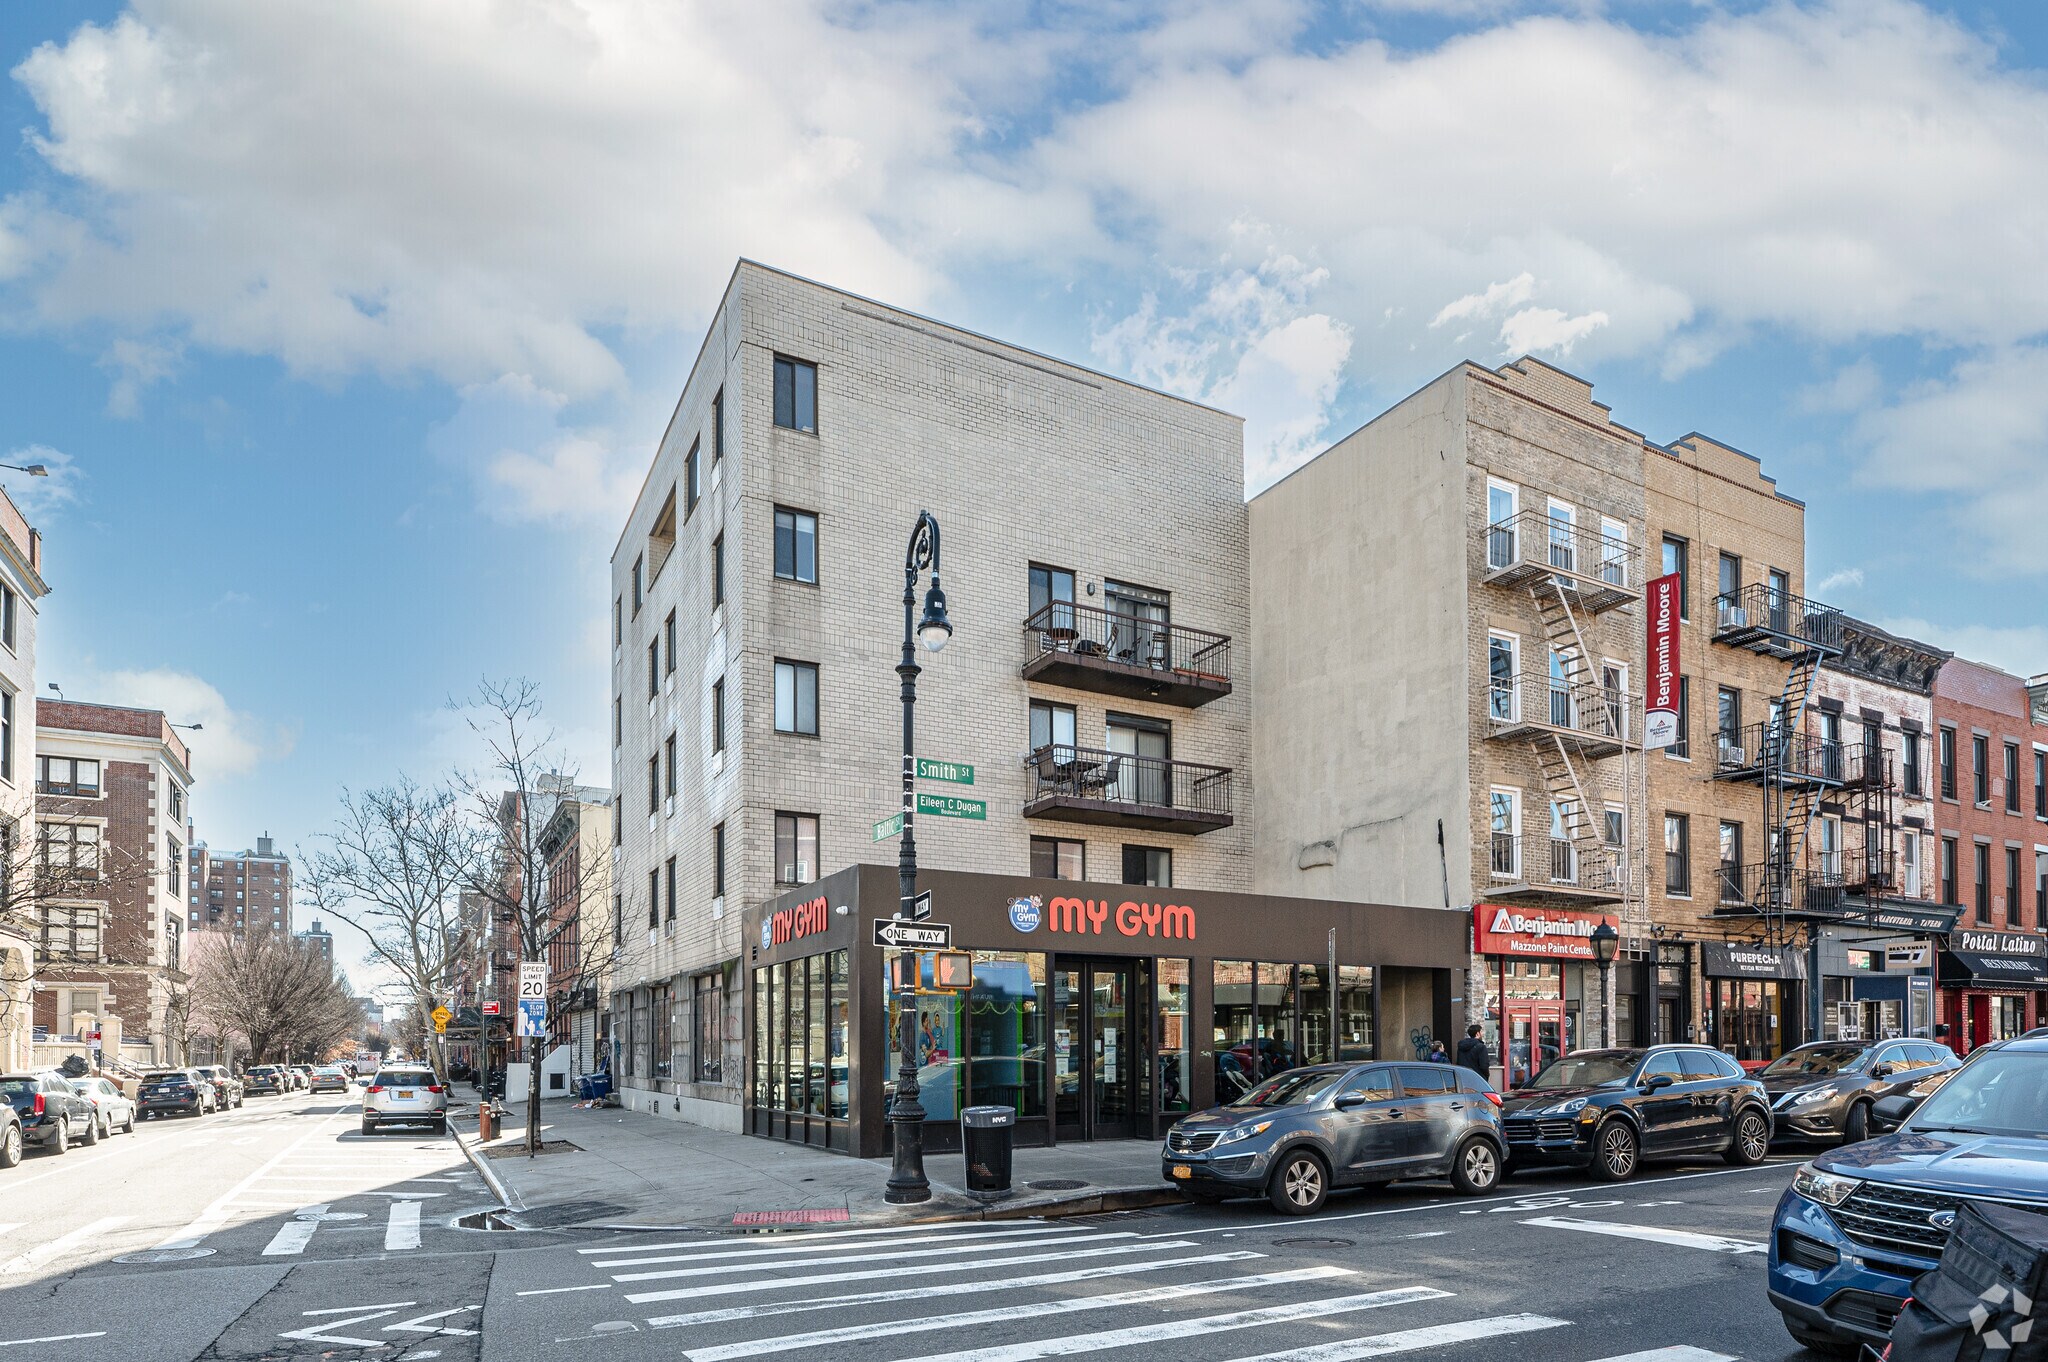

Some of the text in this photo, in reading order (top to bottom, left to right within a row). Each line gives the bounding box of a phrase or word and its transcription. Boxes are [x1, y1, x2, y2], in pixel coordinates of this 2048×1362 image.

[1656, 583, 1673, 706] Benjamin Moore
[920, 761, 969, 780] Smith St
[920, 795, 981, 814] Eileen C Dugan
[917, 900, 928, 914] WAY
[773, 908, 794, 945] MY
[795, 896, 828, 939] GYM
[1016, 912, 1037, 922] GYM
[1049, 896, 1196, 940] MY GYM
[1514, 914, 1618, 938] Benjamin Moe
[886, 928, 941, 942] ONE WAY
[1962, 932, 2036, 953] Portal Latino
[1511, 940, 1546, 952] Mazzone
[1548, 942, 1568, 953] Paint
[522, 965, 545, 973] SPEED
[522, 982, 542, 995] 20
